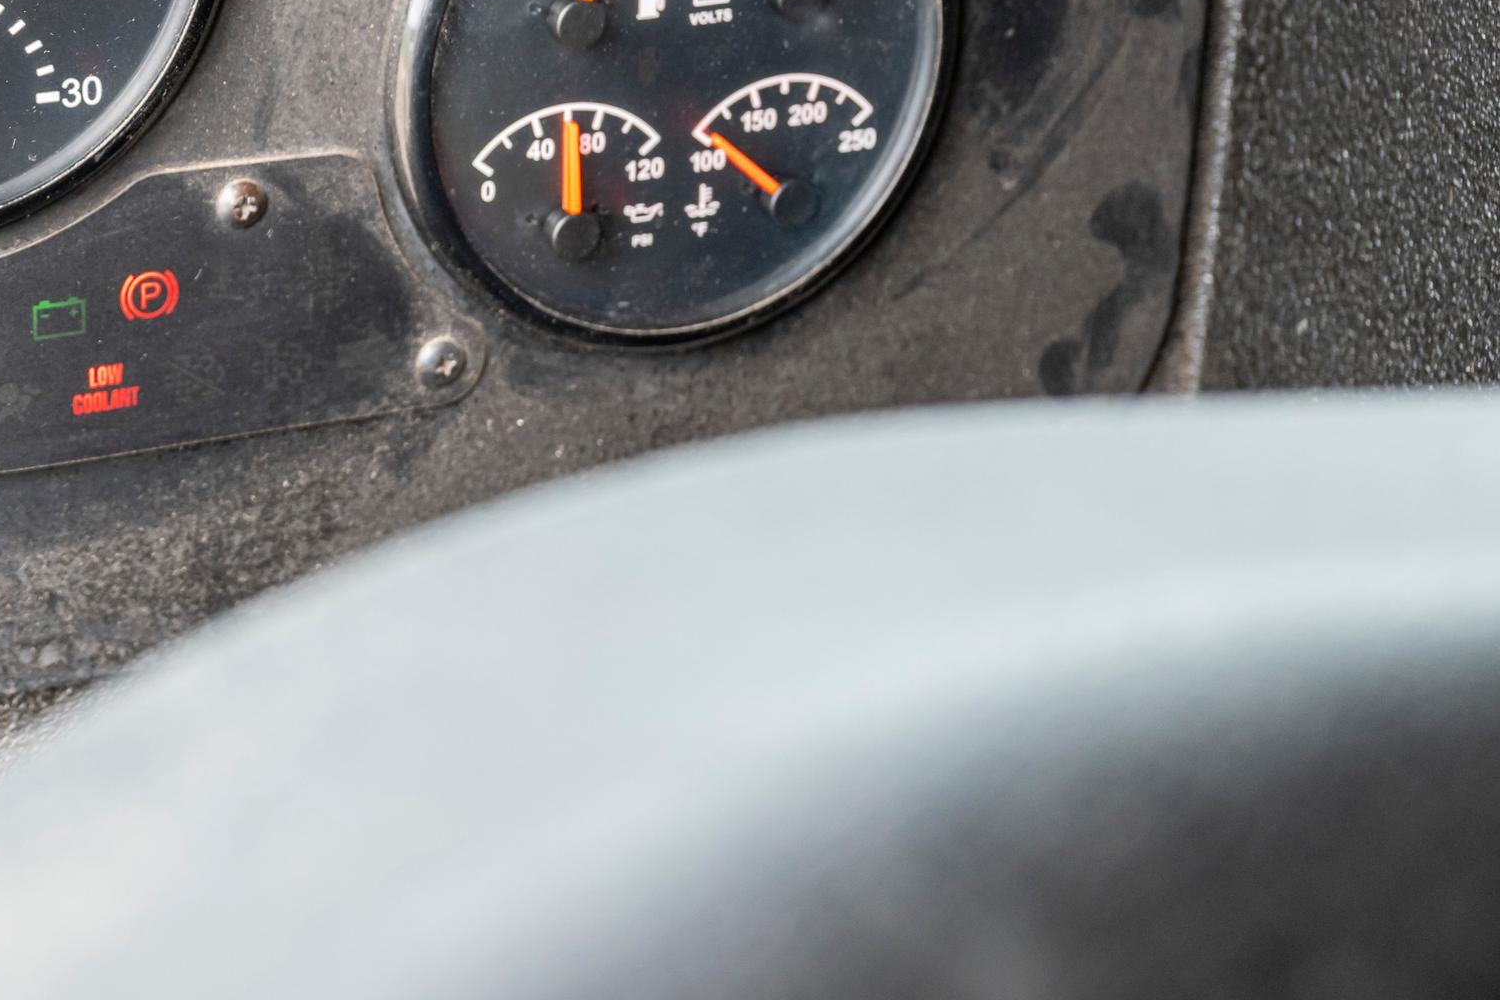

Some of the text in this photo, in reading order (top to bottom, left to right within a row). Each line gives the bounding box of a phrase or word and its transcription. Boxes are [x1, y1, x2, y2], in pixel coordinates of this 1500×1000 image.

[689, 8, 733, 26] VOLTS
[60, 76, 103, 107] 30
[740, 107, 778, 132] 150
[787, 102, 828, 128] 200
[526, 138, 555, 161] 40
[579, 131, 606, 155] 80
[838, 128, 877, 154] 250
[625, 157, 665, 182] 120
[690, 149, 727, 174] 100
[481, 181, 496, 203] 0
[140, 281, 162, 310] P
[88, 362, 124, 389] LOW
[72, 385, 140, 416] COOLANT
